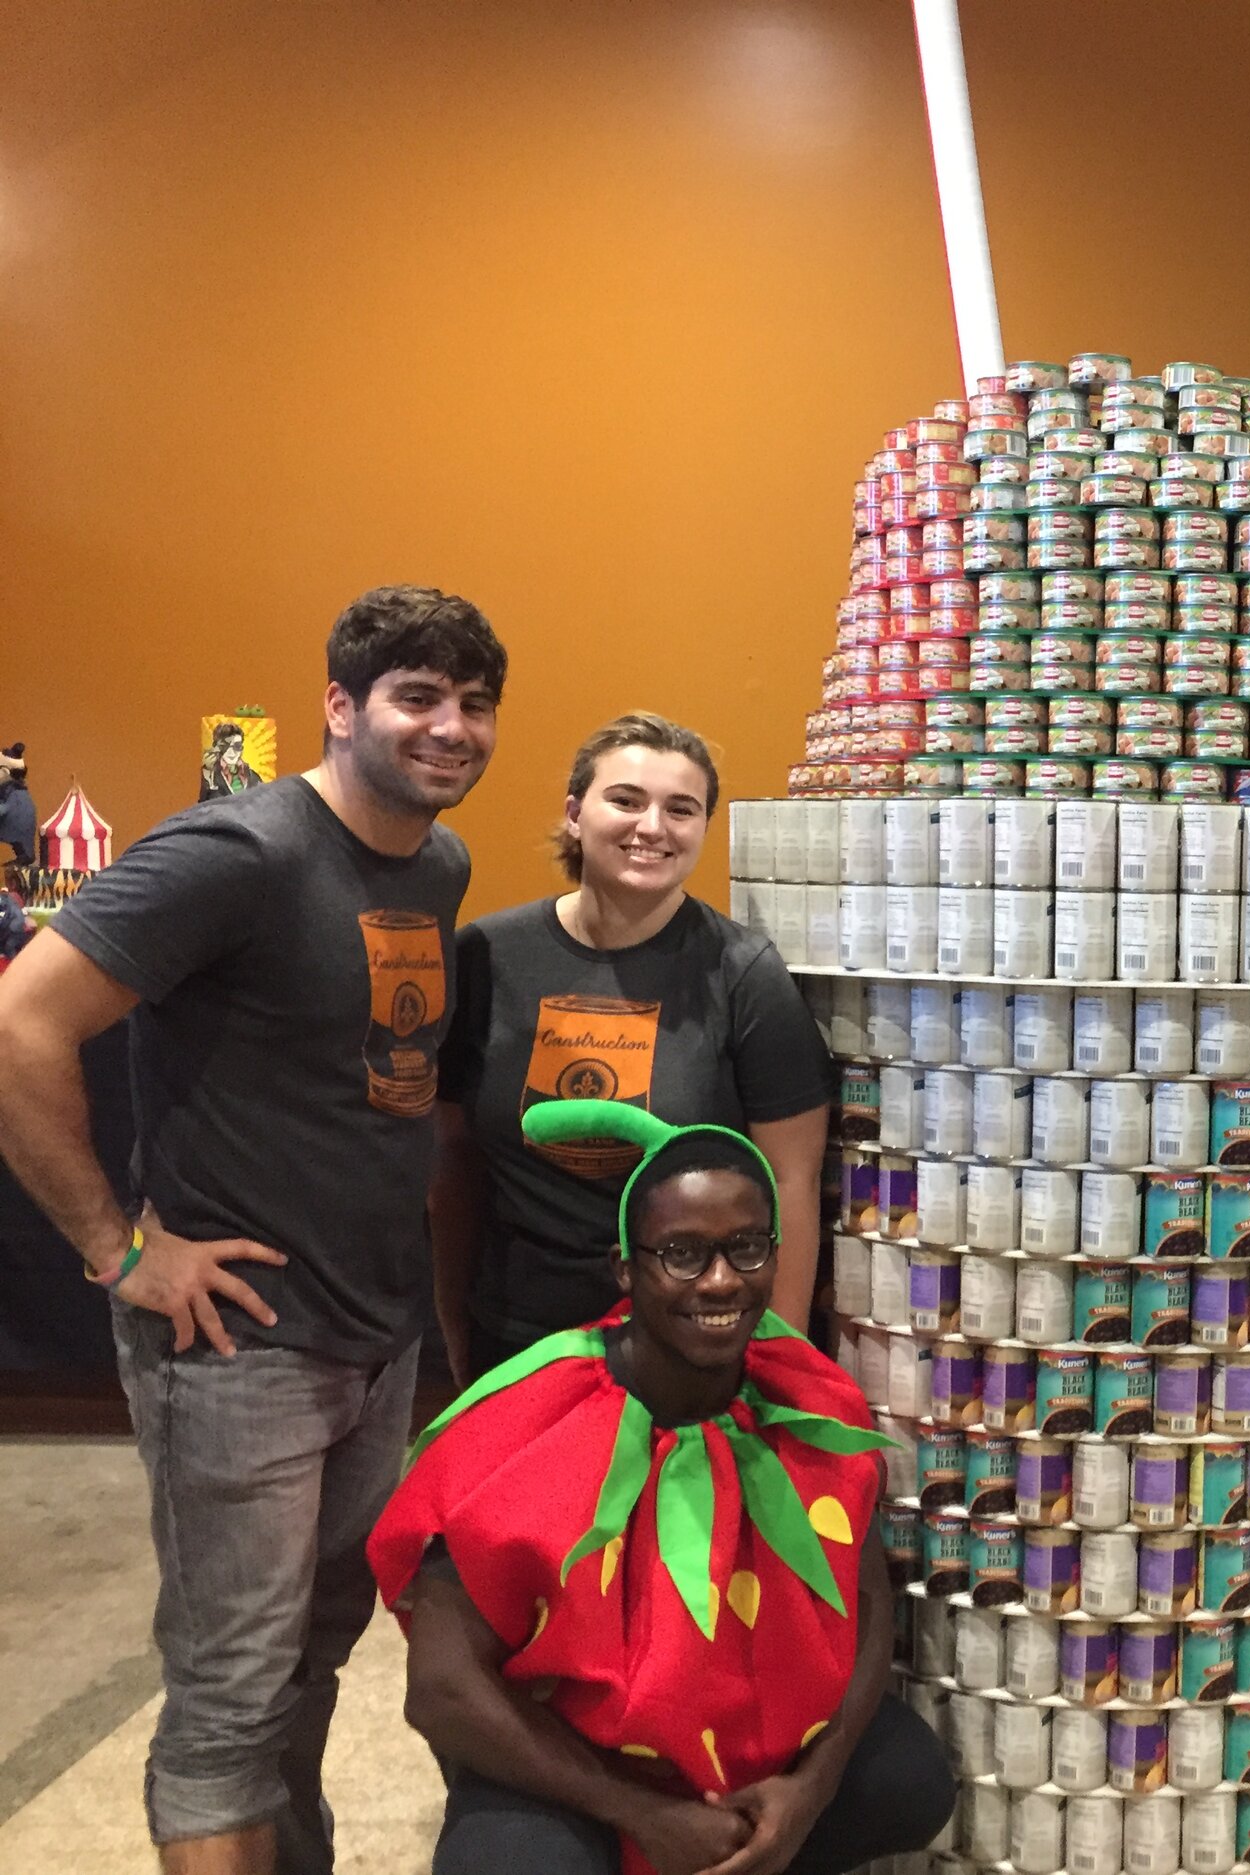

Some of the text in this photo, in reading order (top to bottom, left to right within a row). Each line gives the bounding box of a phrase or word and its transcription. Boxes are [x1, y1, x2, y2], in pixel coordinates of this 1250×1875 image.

[372, 949, 443, 971] Construction
[541, 1028, 651, 1051] Construction
[983, 1530, 1016, 1542] Kuner's
